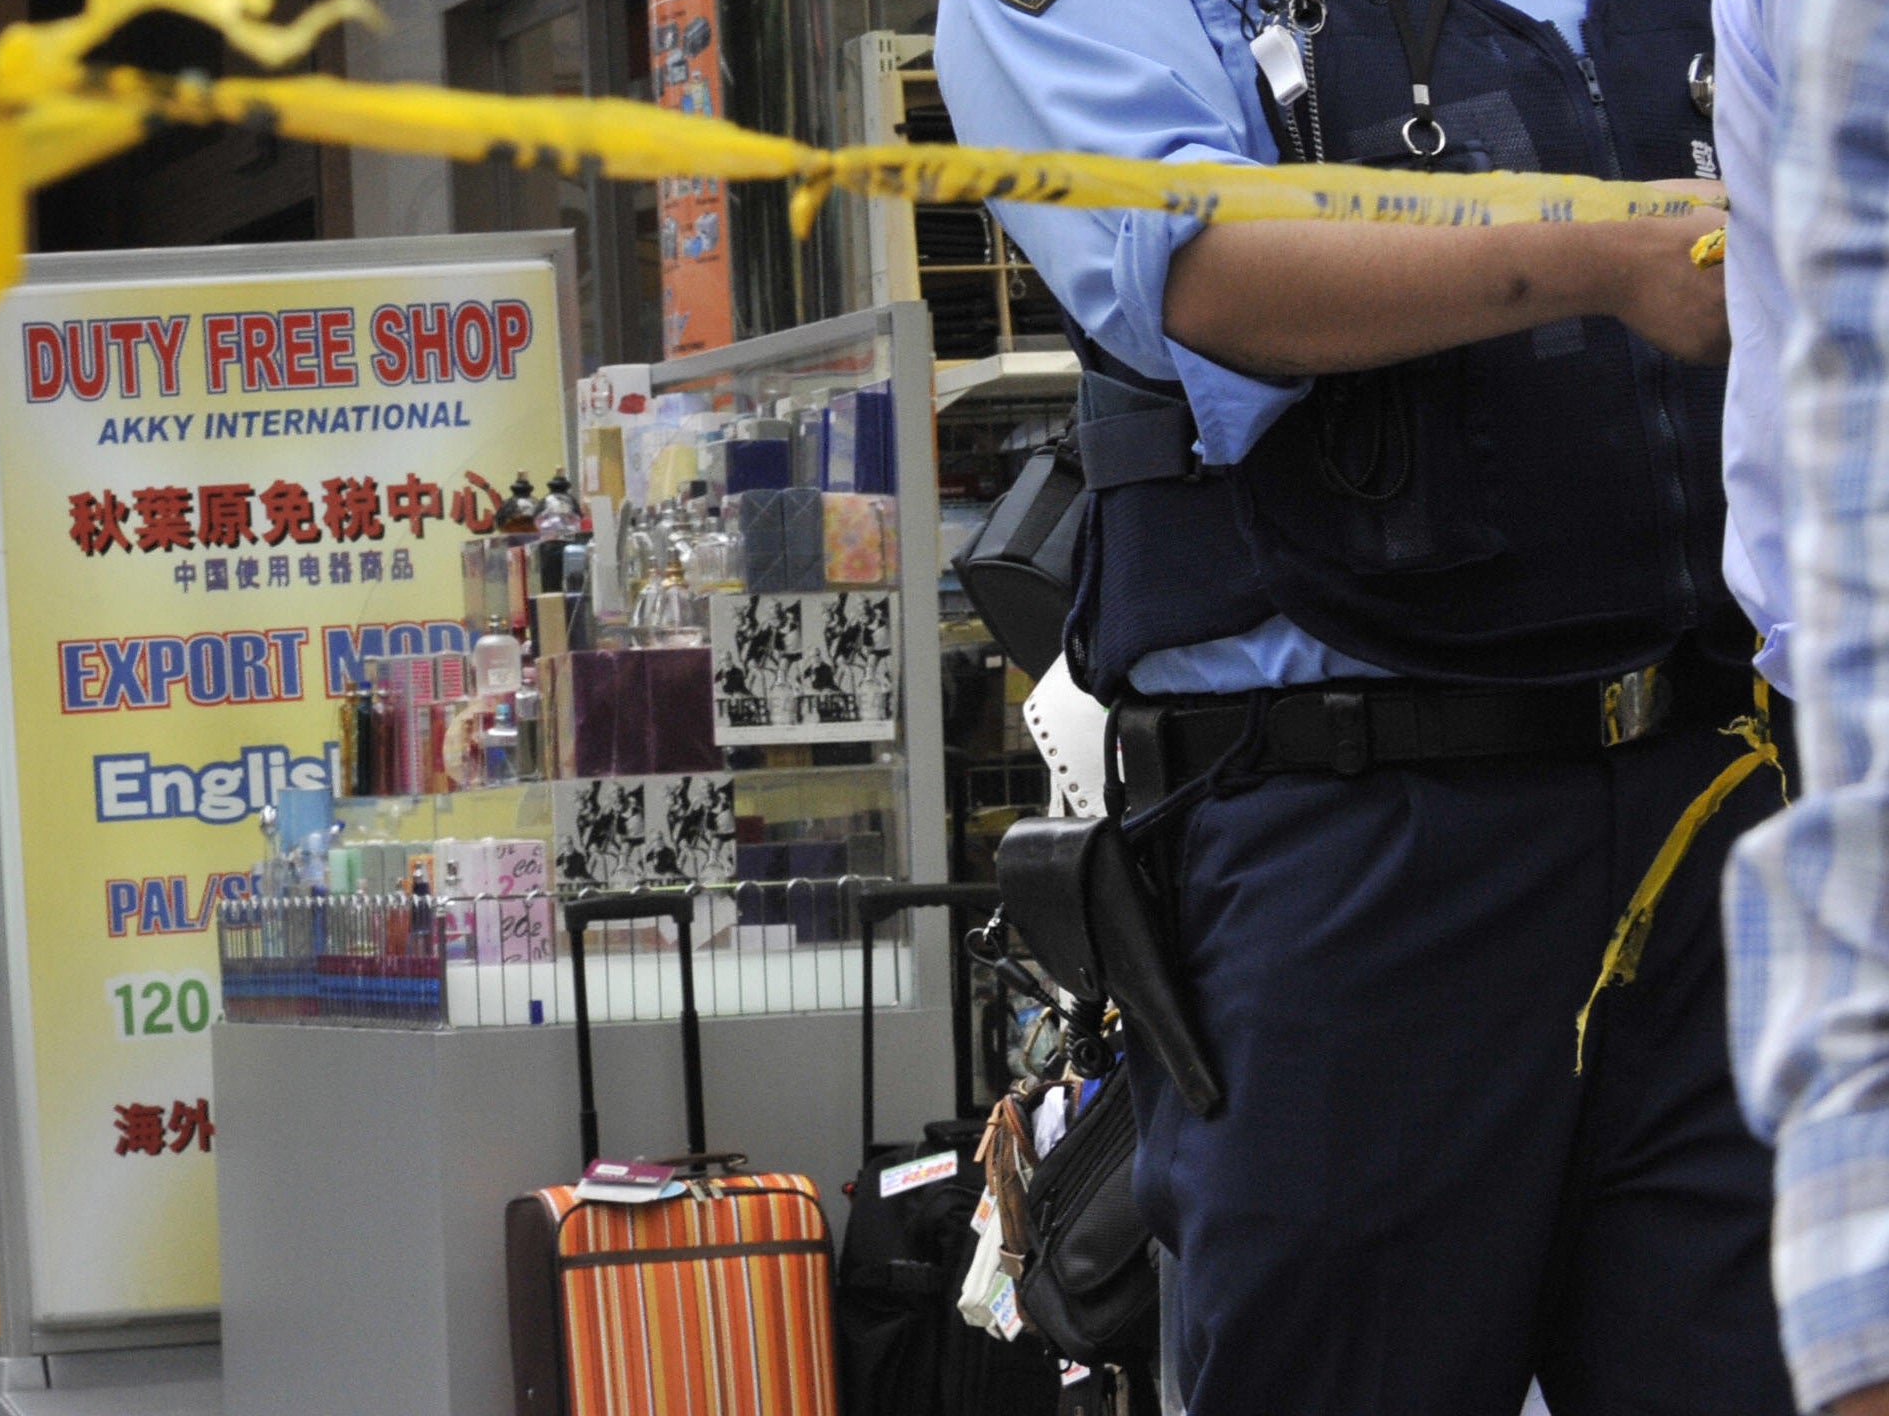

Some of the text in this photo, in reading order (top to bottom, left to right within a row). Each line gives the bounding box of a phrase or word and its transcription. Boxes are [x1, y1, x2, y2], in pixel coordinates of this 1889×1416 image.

[22, 300, 533, 404] DUTY FREE SHOP
[98, 400, 472, 446] AKKY INTERNATIONAL
[67, 470, 502, 558] 秋葉原免税中心
[57, 627, 310, 715] EXPORT
[93, 741, 346, 824] Englis
